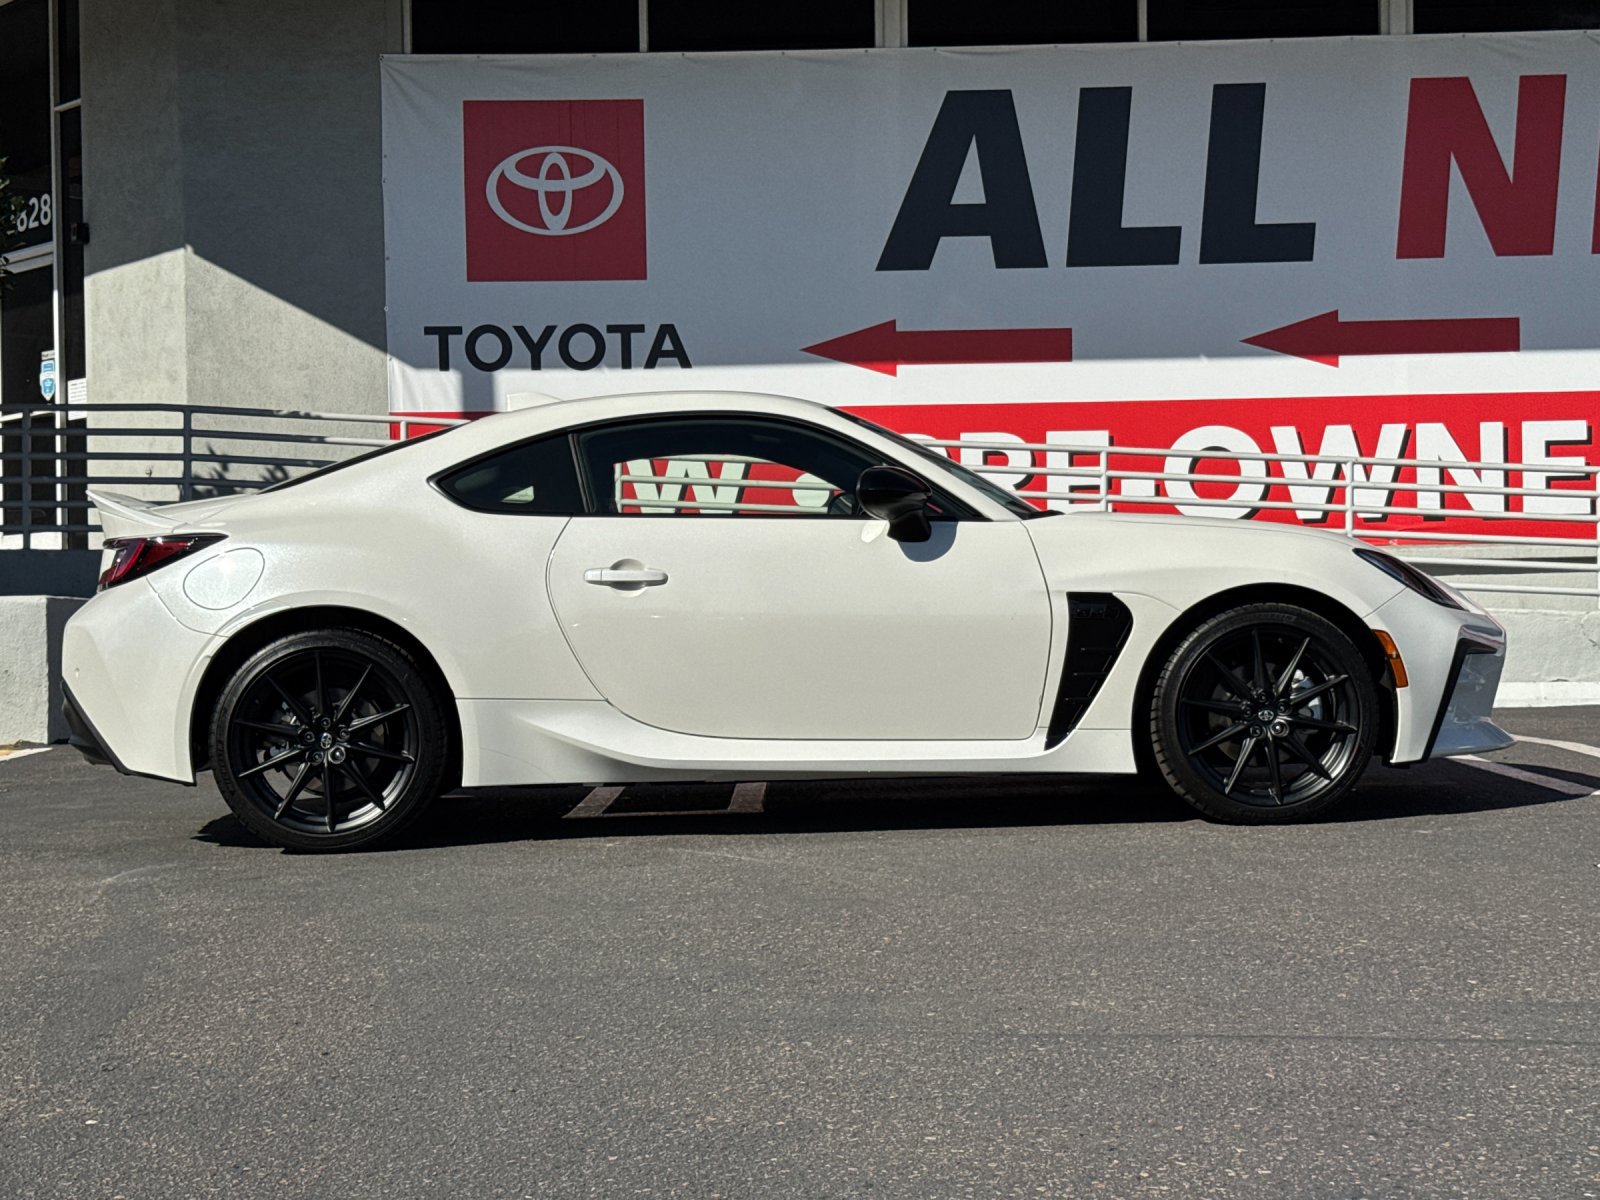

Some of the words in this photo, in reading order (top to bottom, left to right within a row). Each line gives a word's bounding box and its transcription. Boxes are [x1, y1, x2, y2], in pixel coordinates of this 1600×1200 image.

[876, 83, 1316, 271] ALL
[1396, 74, 1600, 259] N
[424, 323, 692, 372] TOYOTA
